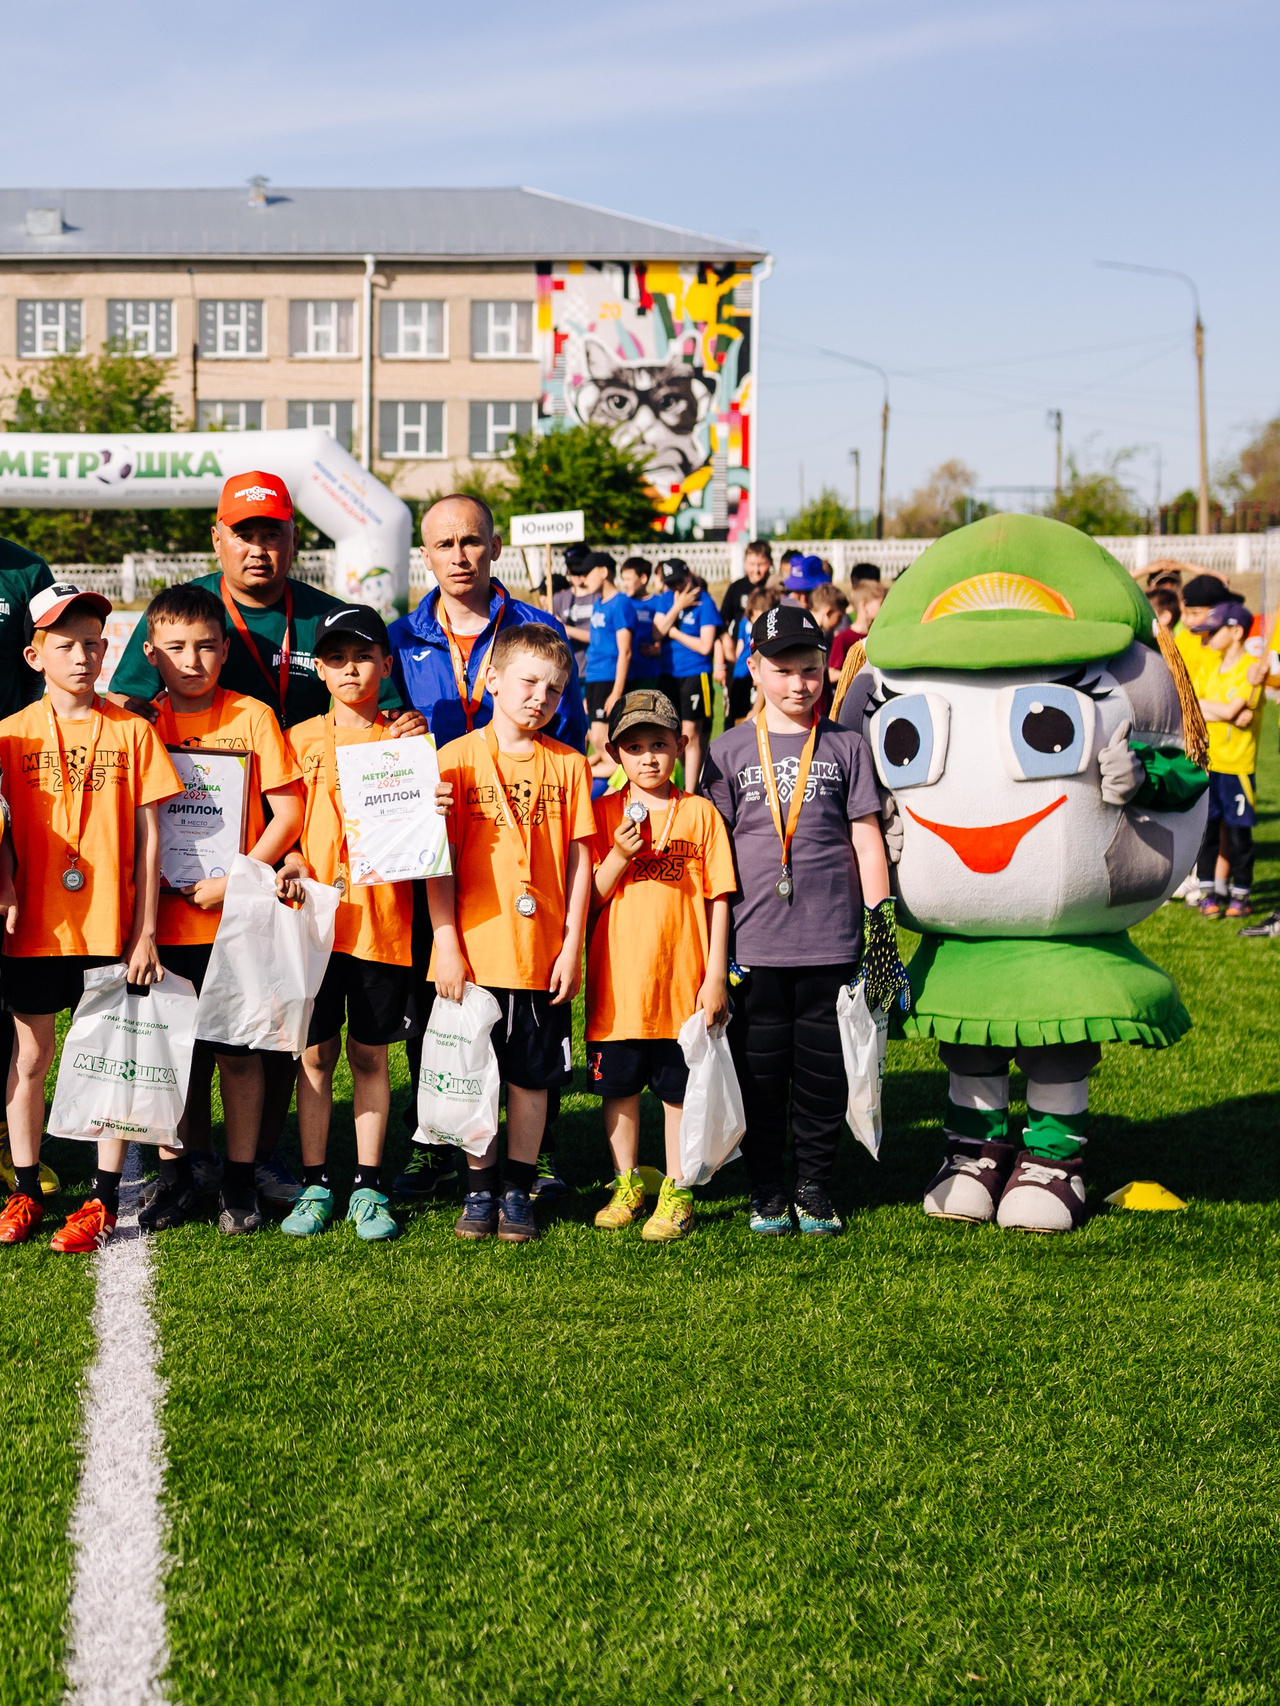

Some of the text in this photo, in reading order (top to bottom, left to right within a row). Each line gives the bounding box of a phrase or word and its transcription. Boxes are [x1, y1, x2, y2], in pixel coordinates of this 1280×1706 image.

[521, 520, 574, 535] Юниор
[690, 694, 700, 711] 7
[184, 783, 221, 792] ТРОШКА
[377, 777, 401, 789] 2025
[183, 791, 207, 800] 2025
[364, 789, 421, 807] ДИПЛОМ
[168, 804, 223, 816] ДИПЛОМ
[633, 858, 685, 882] 2025
[561, 1036, 571, 1072] 1
[73, 1053, 178, 1084] МЕТРОШКА
[91, 1119, 148, 1133] METROSHKA.RU
